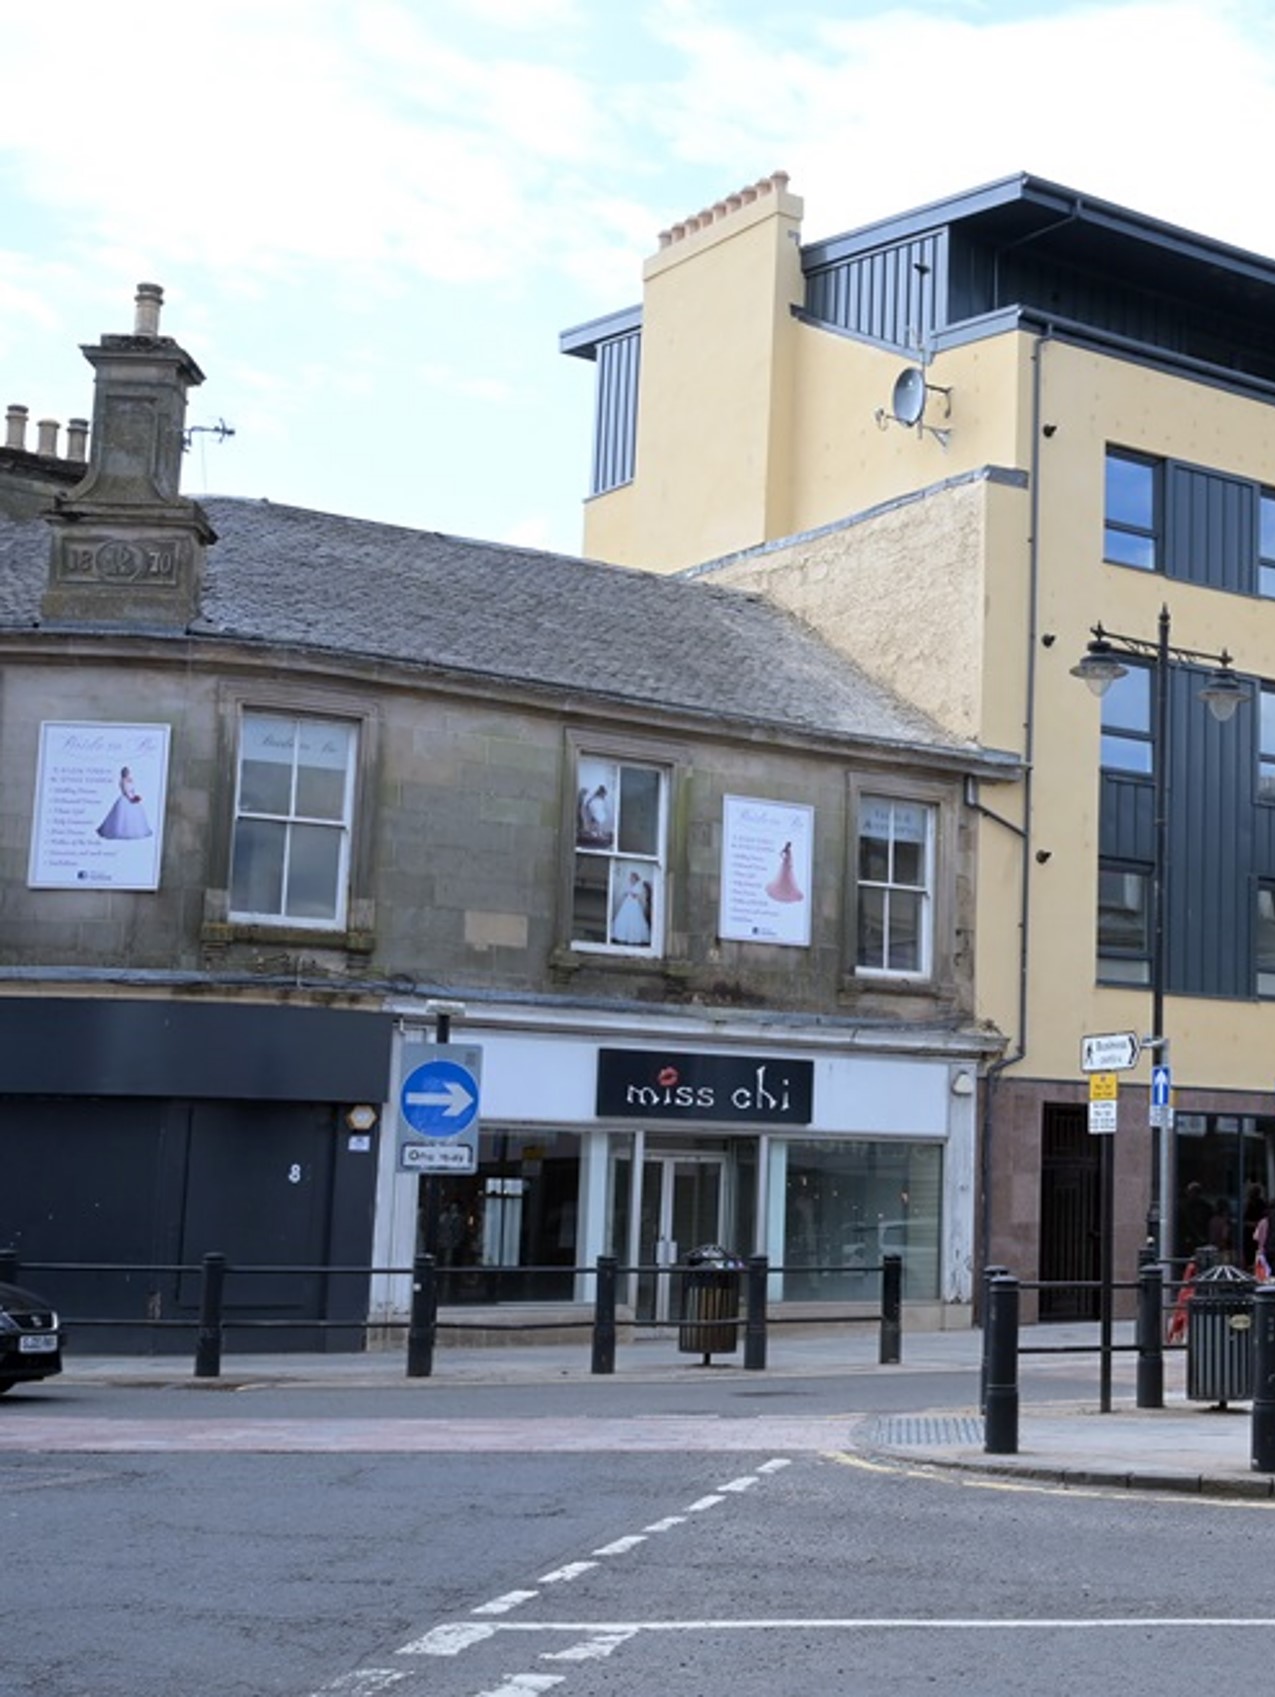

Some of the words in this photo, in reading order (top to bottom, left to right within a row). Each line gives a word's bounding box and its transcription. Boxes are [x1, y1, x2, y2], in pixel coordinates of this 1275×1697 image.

[69, 549, 94, 572] 18
[149, 551, 172, 574] 70
[626, 1080, 715, 1107] miss
[731, 1065, 791, 1111] chi
[288, 1163, 301, 1184] 8
